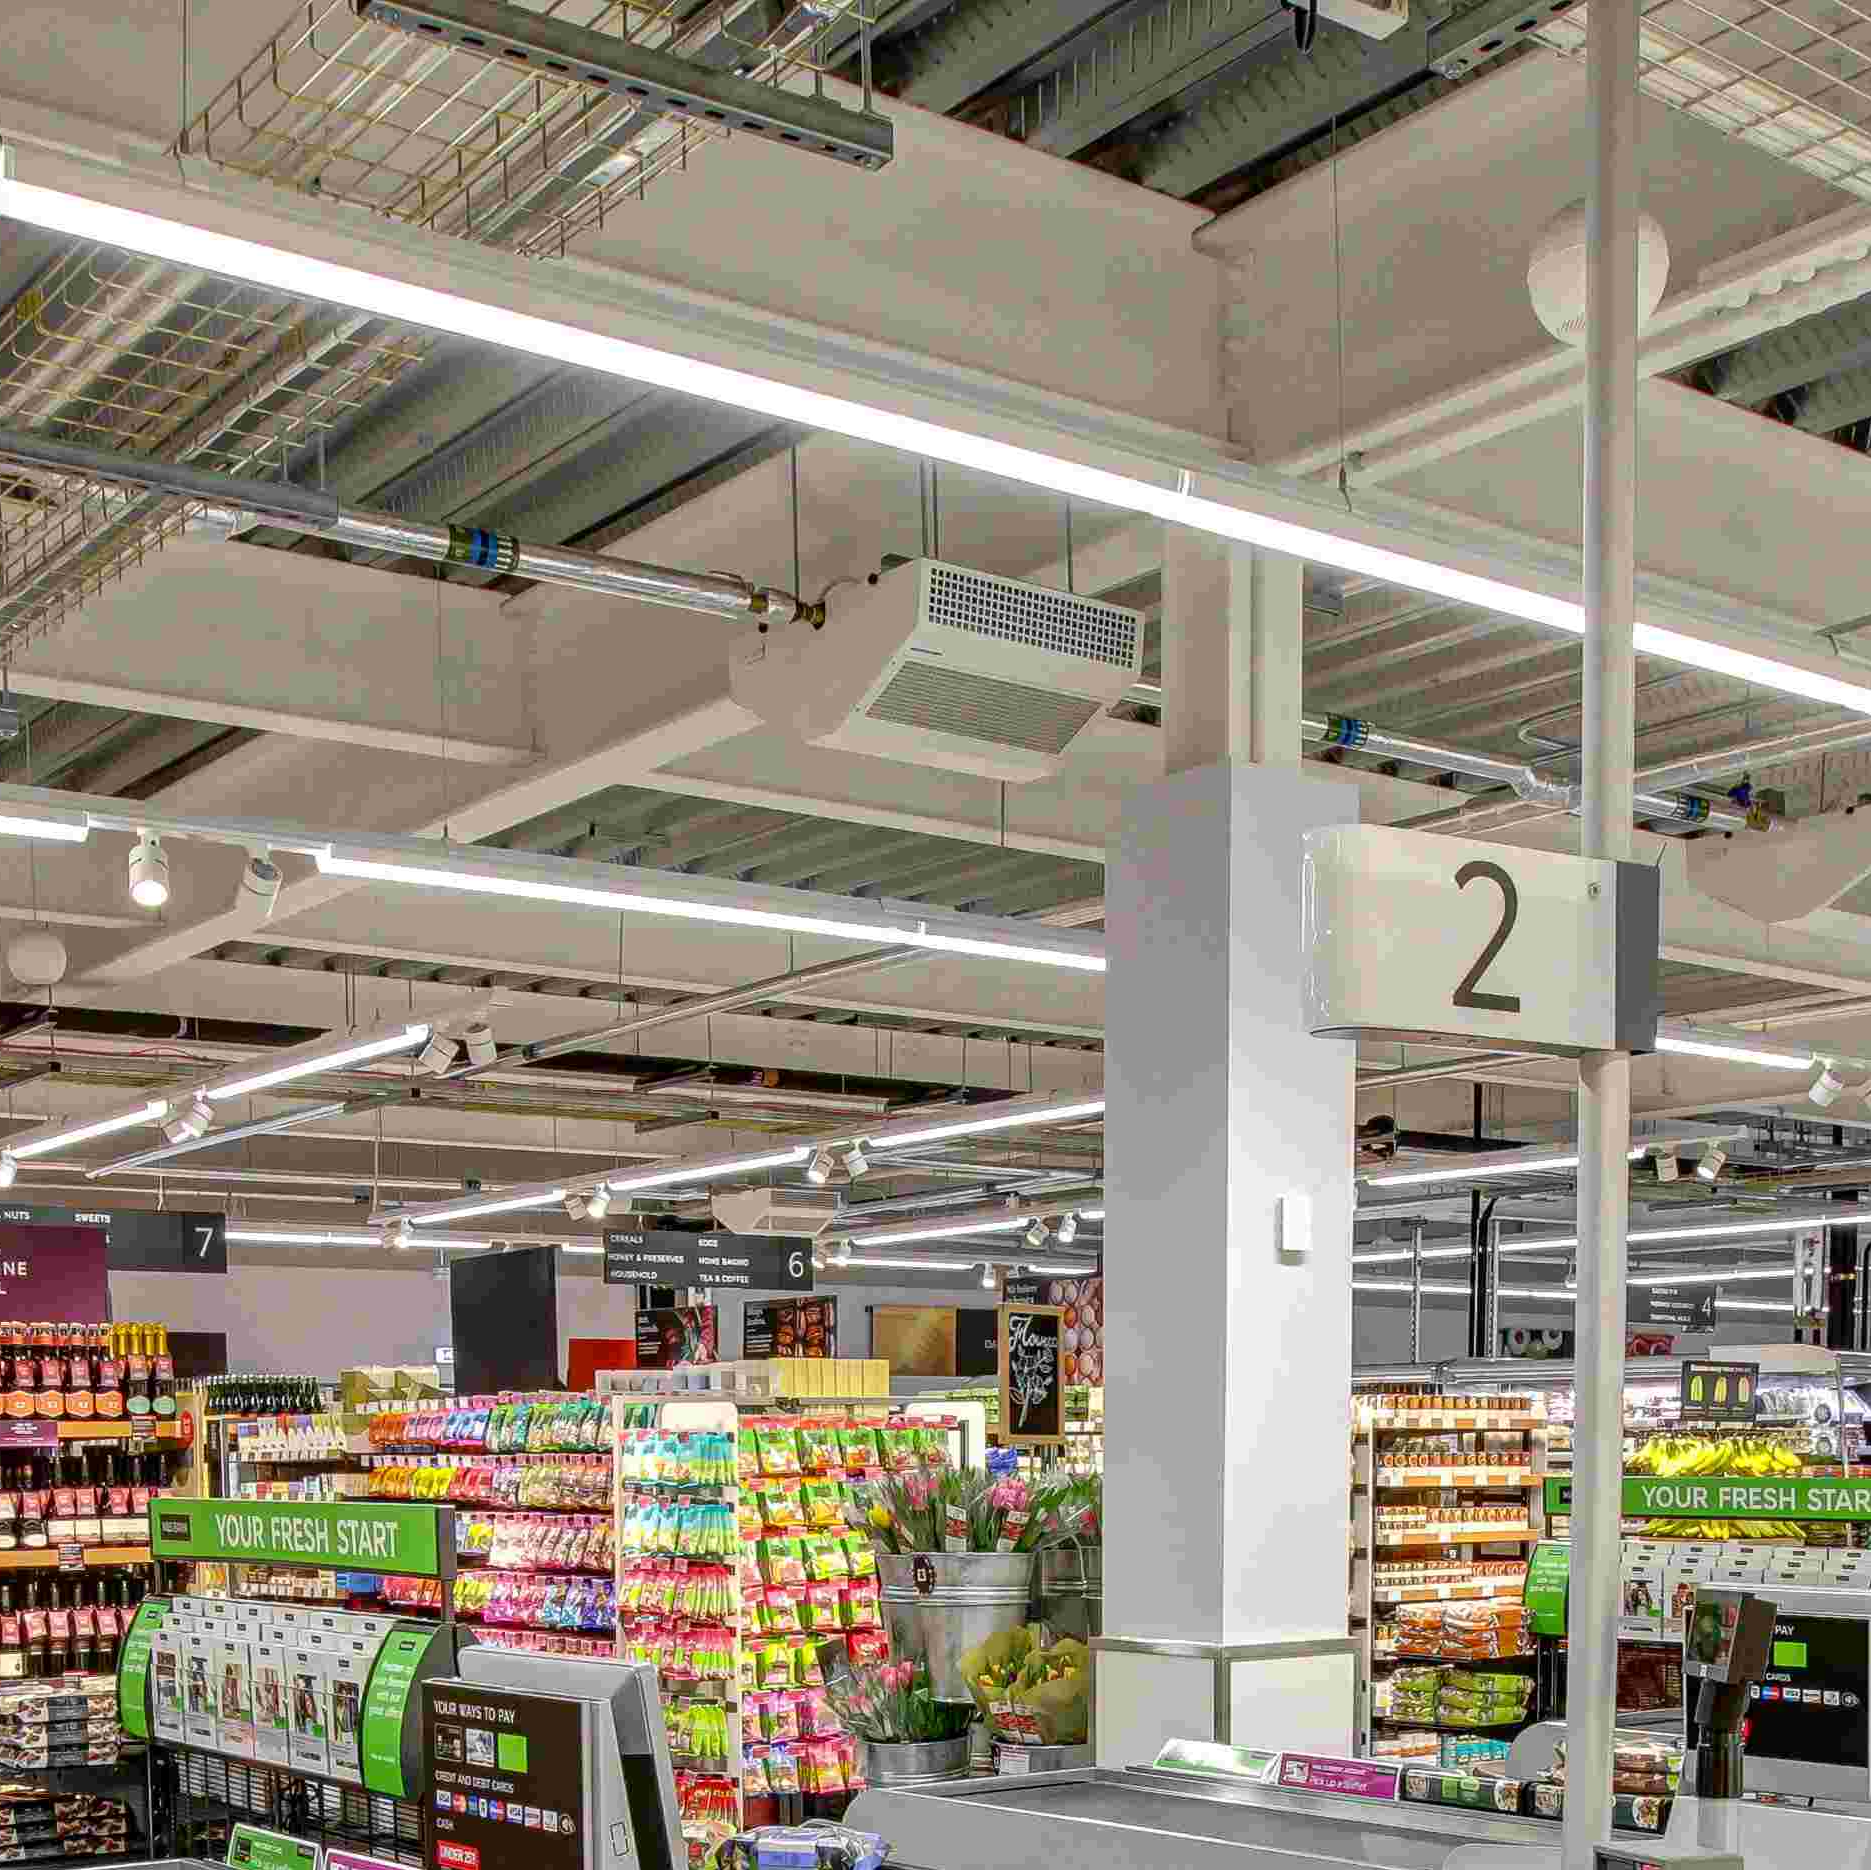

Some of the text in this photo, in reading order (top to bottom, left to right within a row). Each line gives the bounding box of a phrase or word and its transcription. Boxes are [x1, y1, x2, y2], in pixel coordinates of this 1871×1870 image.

[1452, 860, 1520, 1013] 2
[4, 1210, 31, 1220] NUTS
[74, 1213, 110, 1223] SWEETS
[194, 1227, 215, 1257] 7
[609, 1234, 643, 1244] CEREALS
[643, 1254, 685, 1265] PRESERVES
[788, 1252, 804, 1277] 6
[610, 1270, 658, 1280] HOUSEHOLD
[699, 1273, 714, 1283] TEA
[722, 1275, 750, 1285] COFFEE
[1642, 1486, 1708, 1509] YOUR
[1719, 1487, 1796, 1511] FRESH
[215, 1513, 264, 1549] YOUR
[271, 1516, 329, 1553] FRESH
[336, 1519, 398, 1558] START
[1775, 1625, 1794, 1636] PAY
[1765, 1672, 1792, 1682] CARDS
[433, 1700, 515, 1724] YOUR WAYS TO PAY
[457, 1774, 472, 1786] AND
